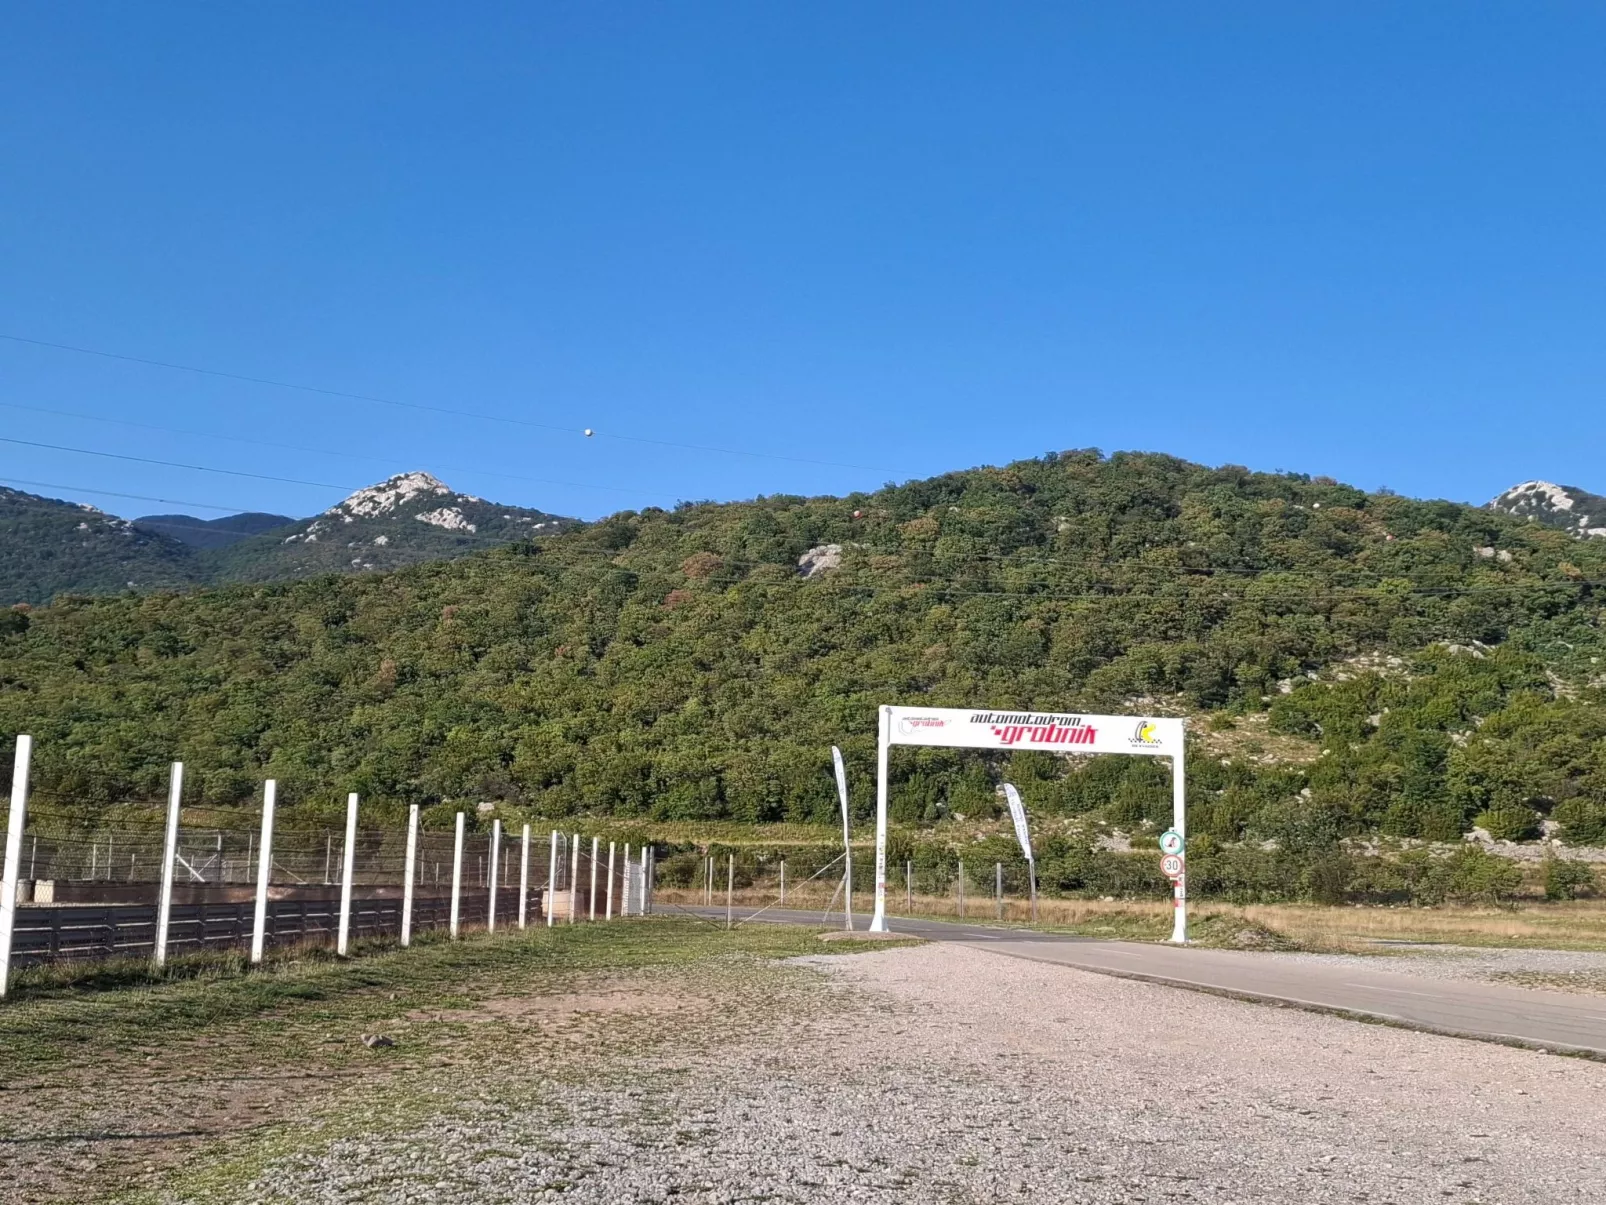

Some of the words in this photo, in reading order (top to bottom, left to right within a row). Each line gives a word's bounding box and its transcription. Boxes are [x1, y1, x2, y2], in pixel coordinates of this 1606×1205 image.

[970, 713, 1081, 726] automotodrom
[1000, 724, 1098, 744] grobnik
[1166, 860, 1178, 870] 30
